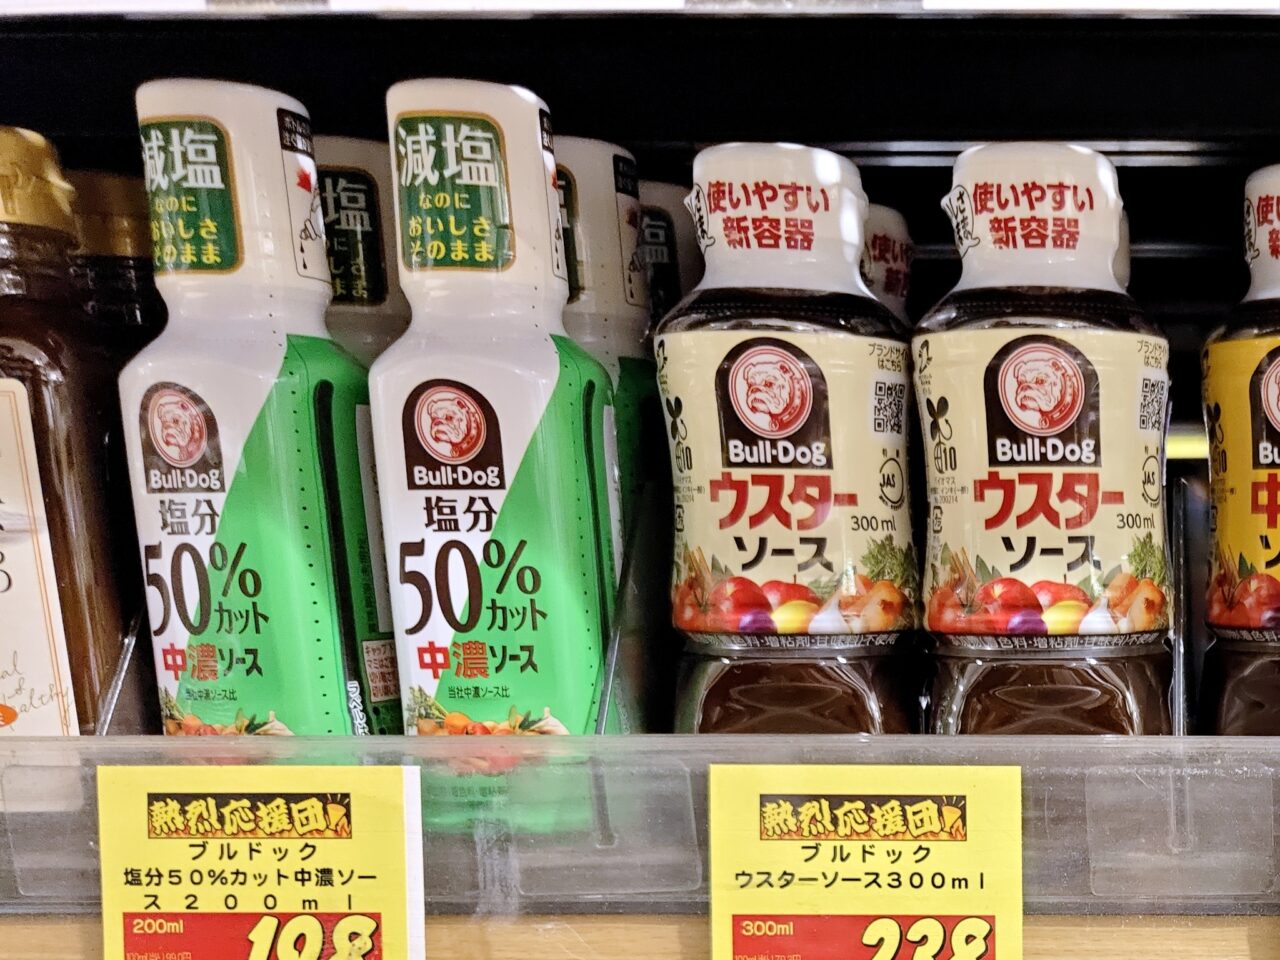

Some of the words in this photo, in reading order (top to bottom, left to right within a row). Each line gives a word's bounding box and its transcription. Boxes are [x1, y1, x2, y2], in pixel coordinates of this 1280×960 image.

[399, 123, 500, 188] 減塩
[419, 192, 470, 210] なのに
[707, 180, 830, 214] 使いやすい
[409, 216, 492, 238] おいしさ
[722, 217, 815, 250] 新容器
[410, 242, 495, 262] そのまま
[424, 496, 497, 533] 塩分
[709, 472, 858, 531] ウスター
[734, 536, 834, 572] ソース
[486, 599, 548, 633] カット
[189, 842, 317, 861] ブルドック
[801, 844, 931, 863] ブルドック
[133, 919, 183, 934] 200ml
[742, 922, 794, 936] 300ml
